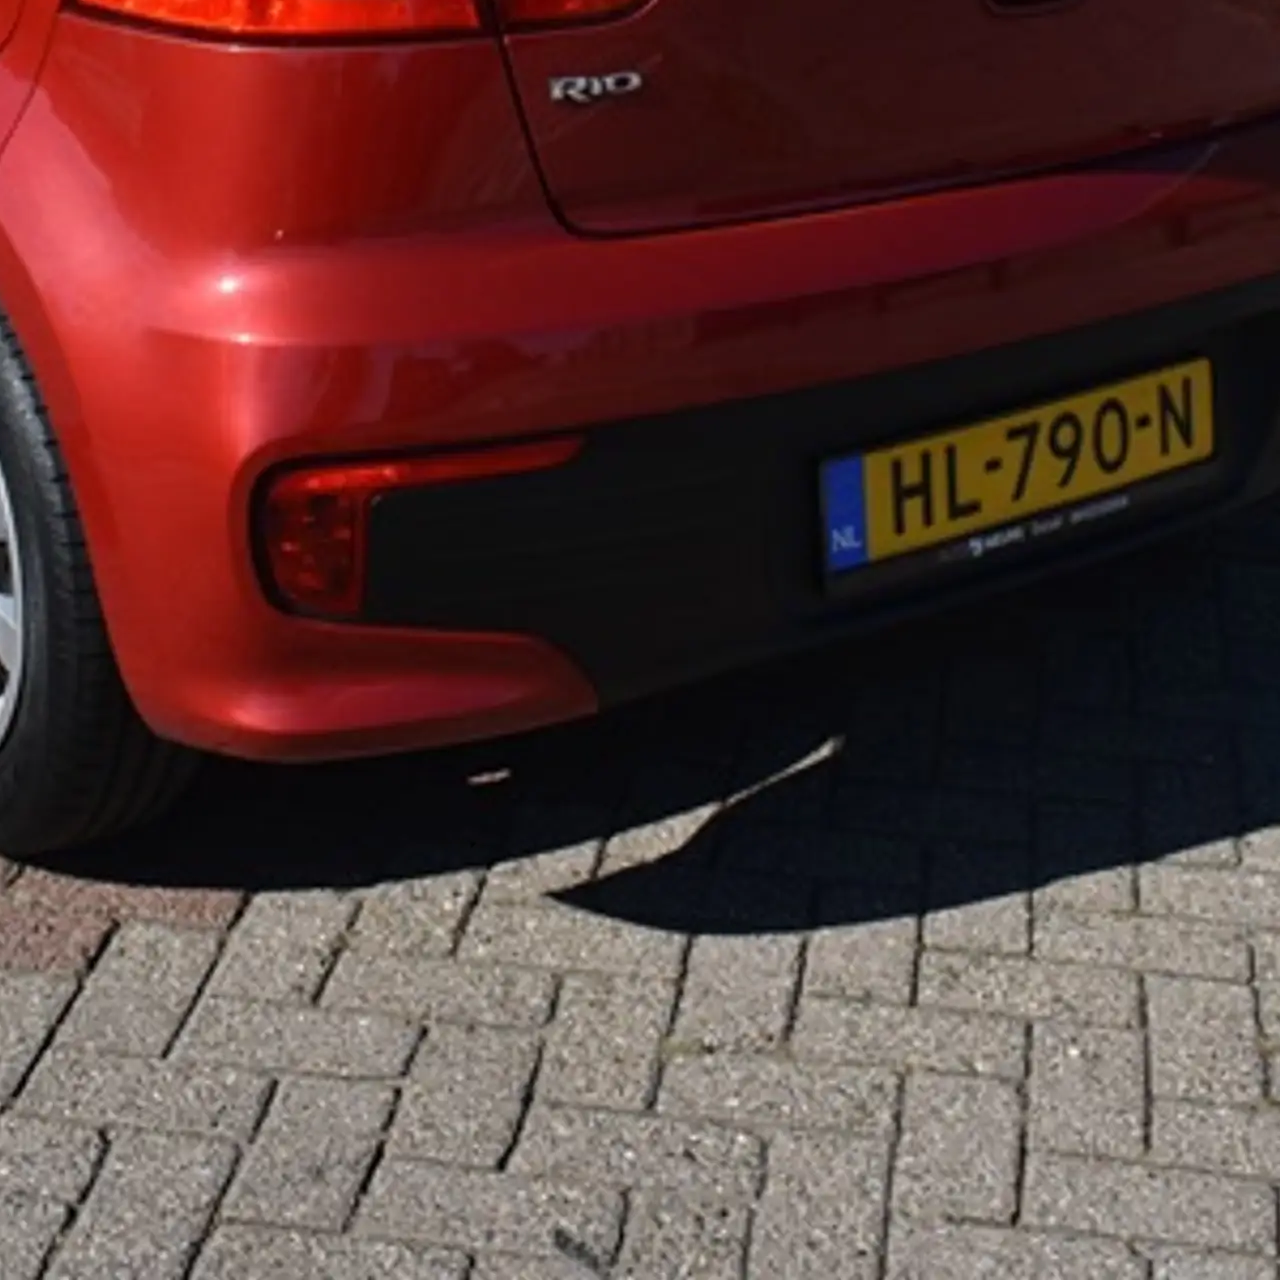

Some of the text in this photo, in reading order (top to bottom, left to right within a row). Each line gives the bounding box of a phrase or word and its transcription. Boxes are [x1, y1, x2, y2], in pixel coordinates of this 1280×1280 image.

[549, 71, 642, 103] RIO
[889, 376, 1195, 536] HL-790-N
[831, 524, 862, 553] NL
